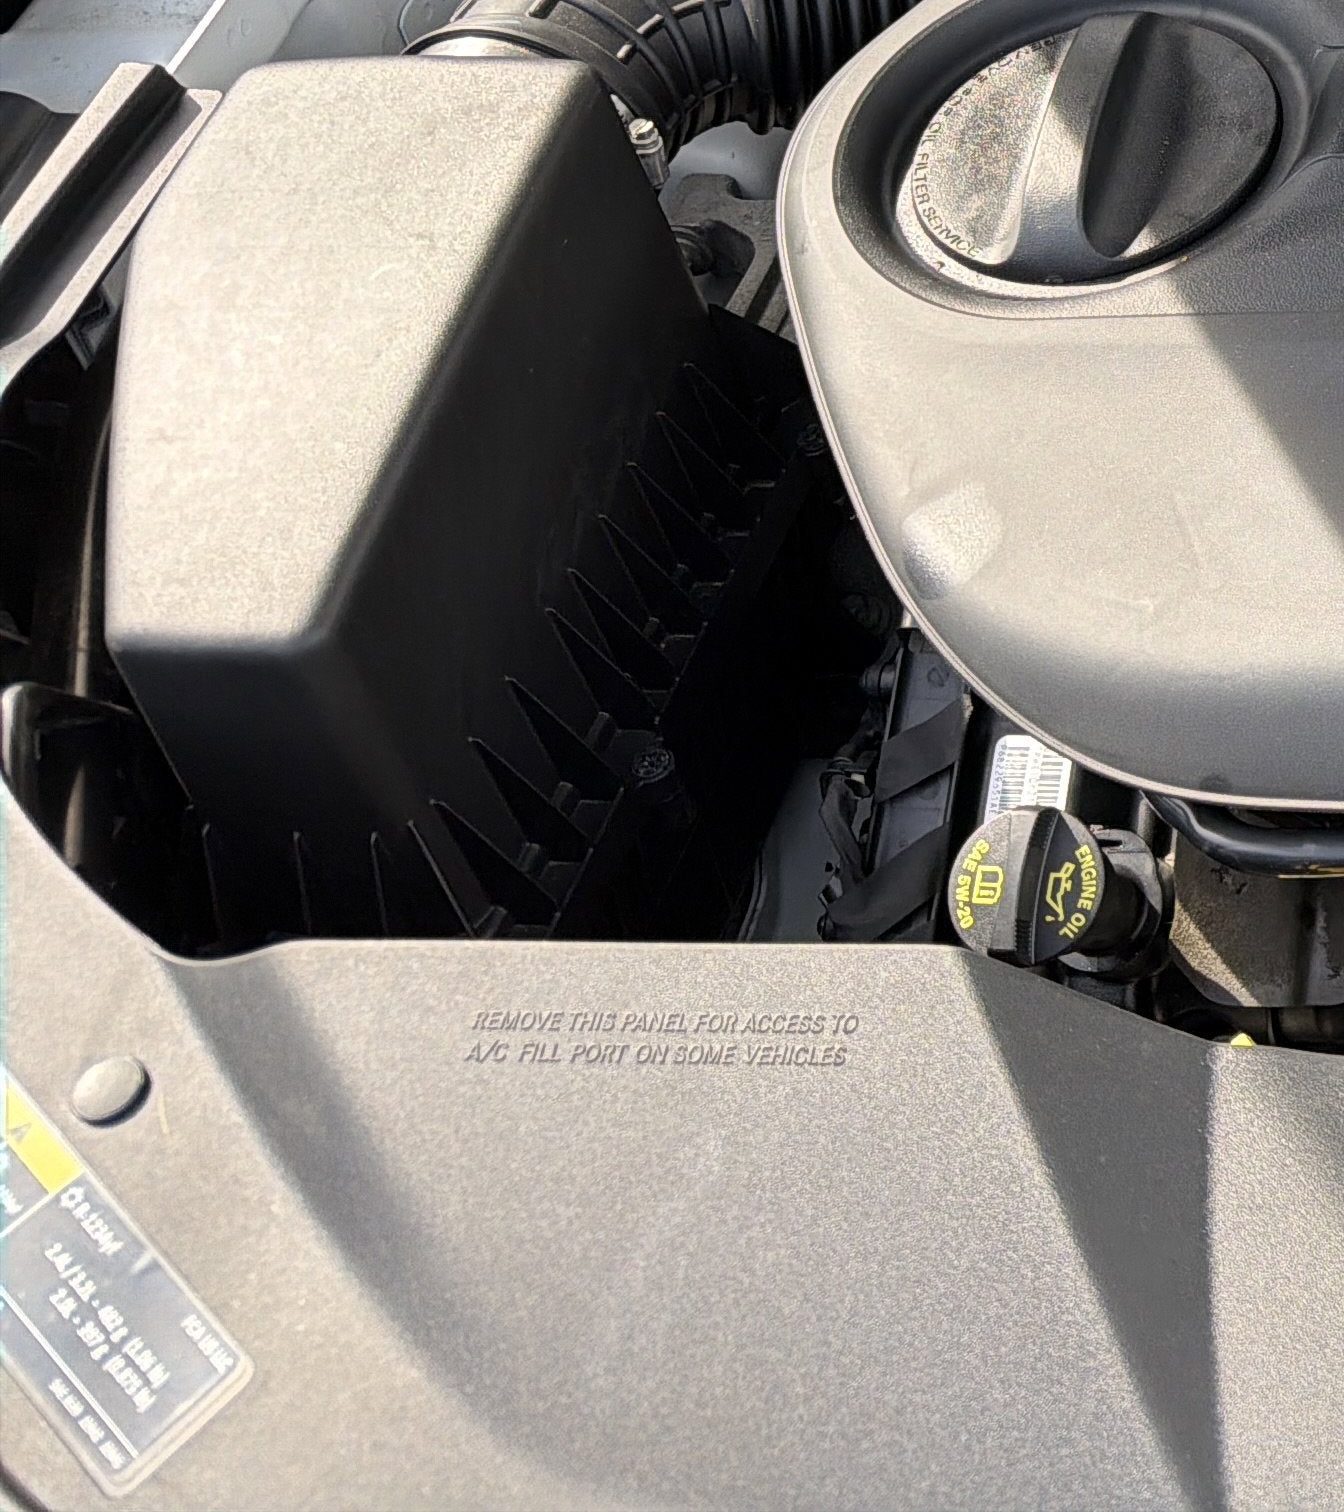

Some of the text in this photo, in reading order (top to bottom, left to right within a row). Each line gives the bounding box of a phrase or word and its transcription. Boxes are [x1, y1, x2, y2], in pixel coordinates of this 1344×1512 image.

[913, 152, 930, 212] FILTER
[953, 838, 990, 930] SAE 5W-20
[1058, 844, 1101, 939] ENGINE OIL
[471, 1010, 859, 1034] REMOVE THIS PANEL FOR ACCESS TO
[463, 1042, 848, 1066] A/C FILL PORT ON SOME VEHICLES
